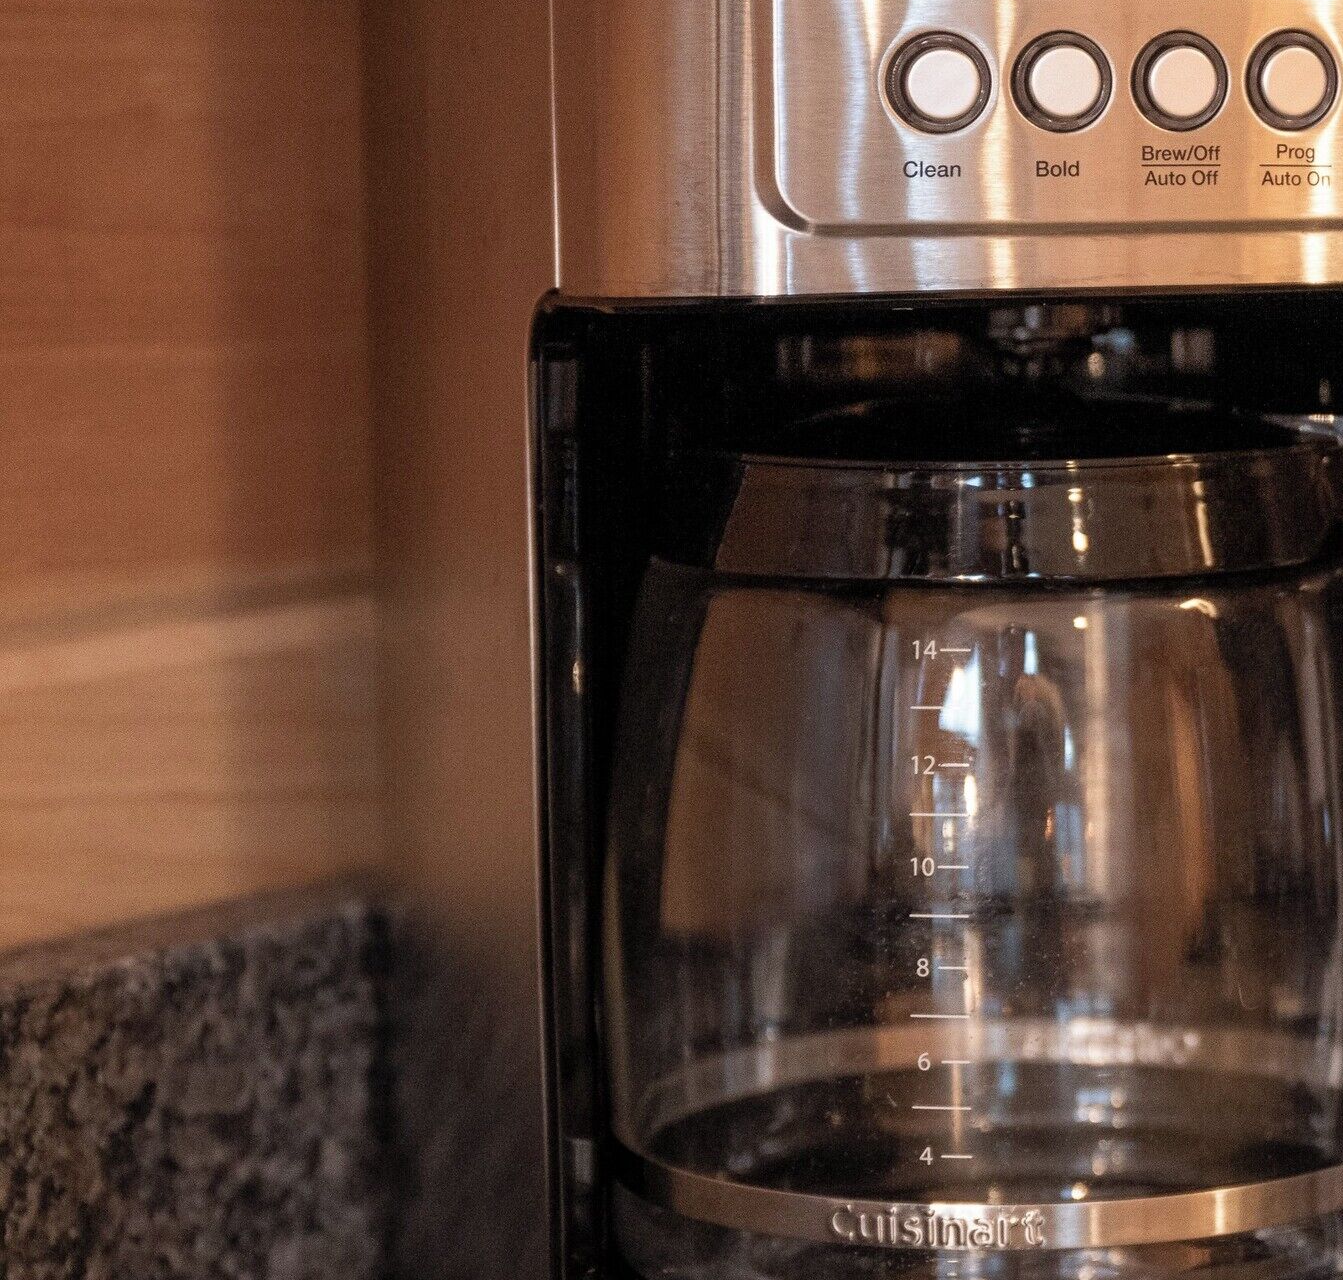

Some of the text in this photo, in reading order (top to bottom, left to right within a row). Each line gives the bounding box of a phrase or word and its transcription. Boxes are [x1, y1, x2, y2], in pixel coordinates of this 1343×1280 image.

[1141, 145, 1221, 161] Brew/Off
[1276, 144, 1315, 163] Prog
[903, 160, 962, 178] Clean
[1036, 160, 1080, 177] Bold
[1144, 171, 1219, 186] Auto Off
[1261, 171, 1331, 187] Auto On
[912, 640, 937, 659] 14
[911, 755, 936, 775] 12
[910, 857, 935, 876] 10
[916, 958, 930, 977] 8
[917, 1052, 931, 1071] 6
[919, 1146, 933, 1166] 4
[832, 1202, 1044, 1248] Cuisinart
